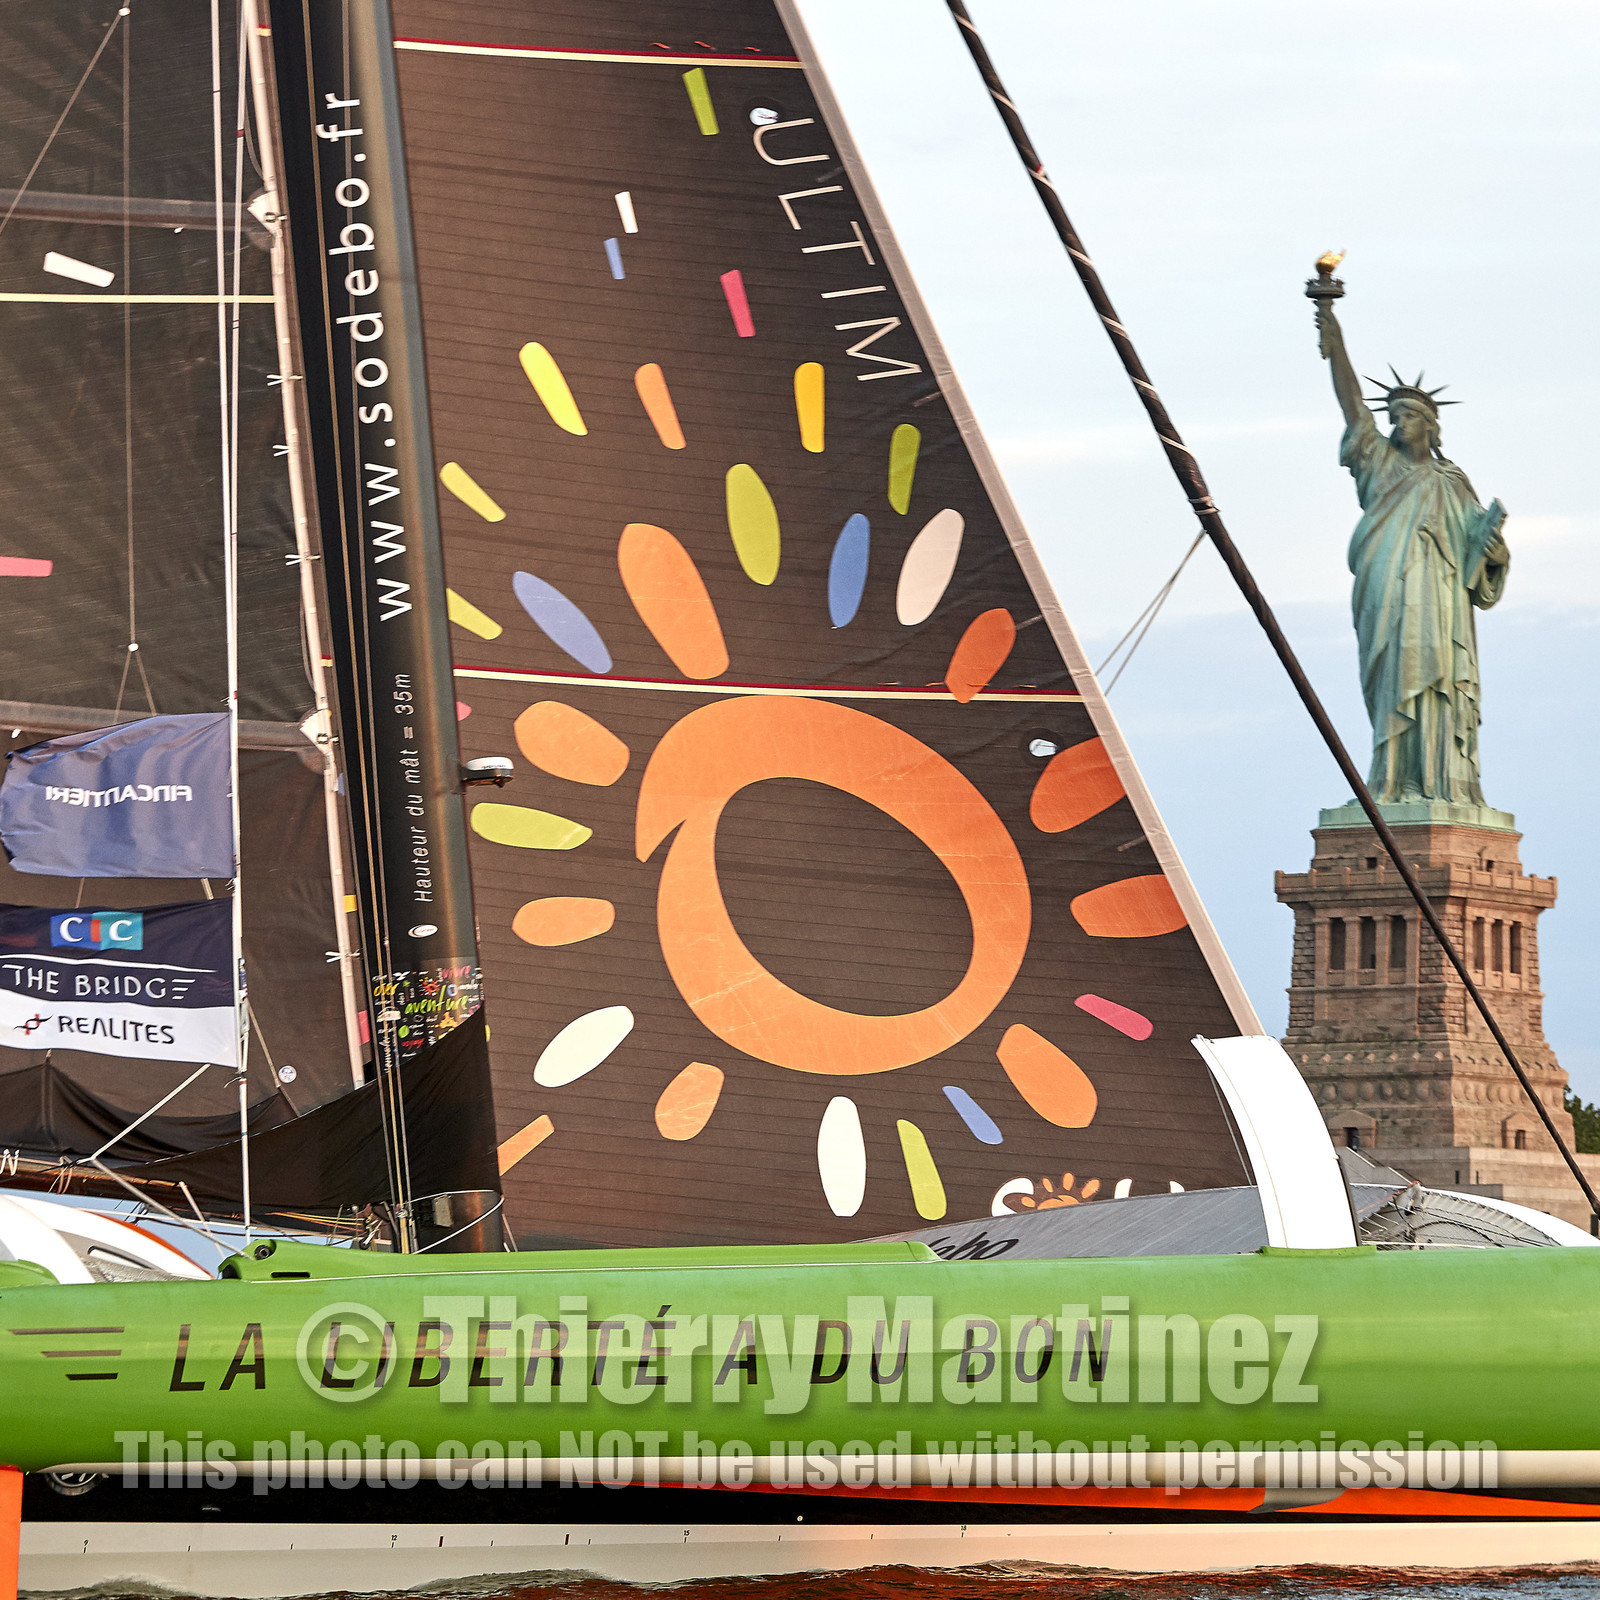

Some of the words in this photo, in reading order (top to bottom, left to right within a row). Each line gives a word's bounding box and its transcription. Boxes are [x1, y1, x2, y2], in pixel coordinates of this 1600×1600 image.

[753, 117, 923, 382] ULTIM
[315, 92, 413, 621] www.sodebo.fr
[393, 674, 414, 715] 35m
[399, 749, 421, 784] mât
[405, 794, 425, 816] du
[411, 826, 433, 902] Hauteur
[59, 916, 134, 943] CIC
[2, 964, 60, 994] THE
[75, 975, 196, 1000] BRIDGE
[405, 985, 469, 1014] aventure
[58, 1015, 176, 1045] REALITES
[169, 1323, 266, 1391] LA
[320, 1304, 677, 1388] LIBERTÉ
[714, 1320, 758, 1385] A
[809, 1320, 911, 1385] DU
[956, 1318, 1113, 1383] BON
